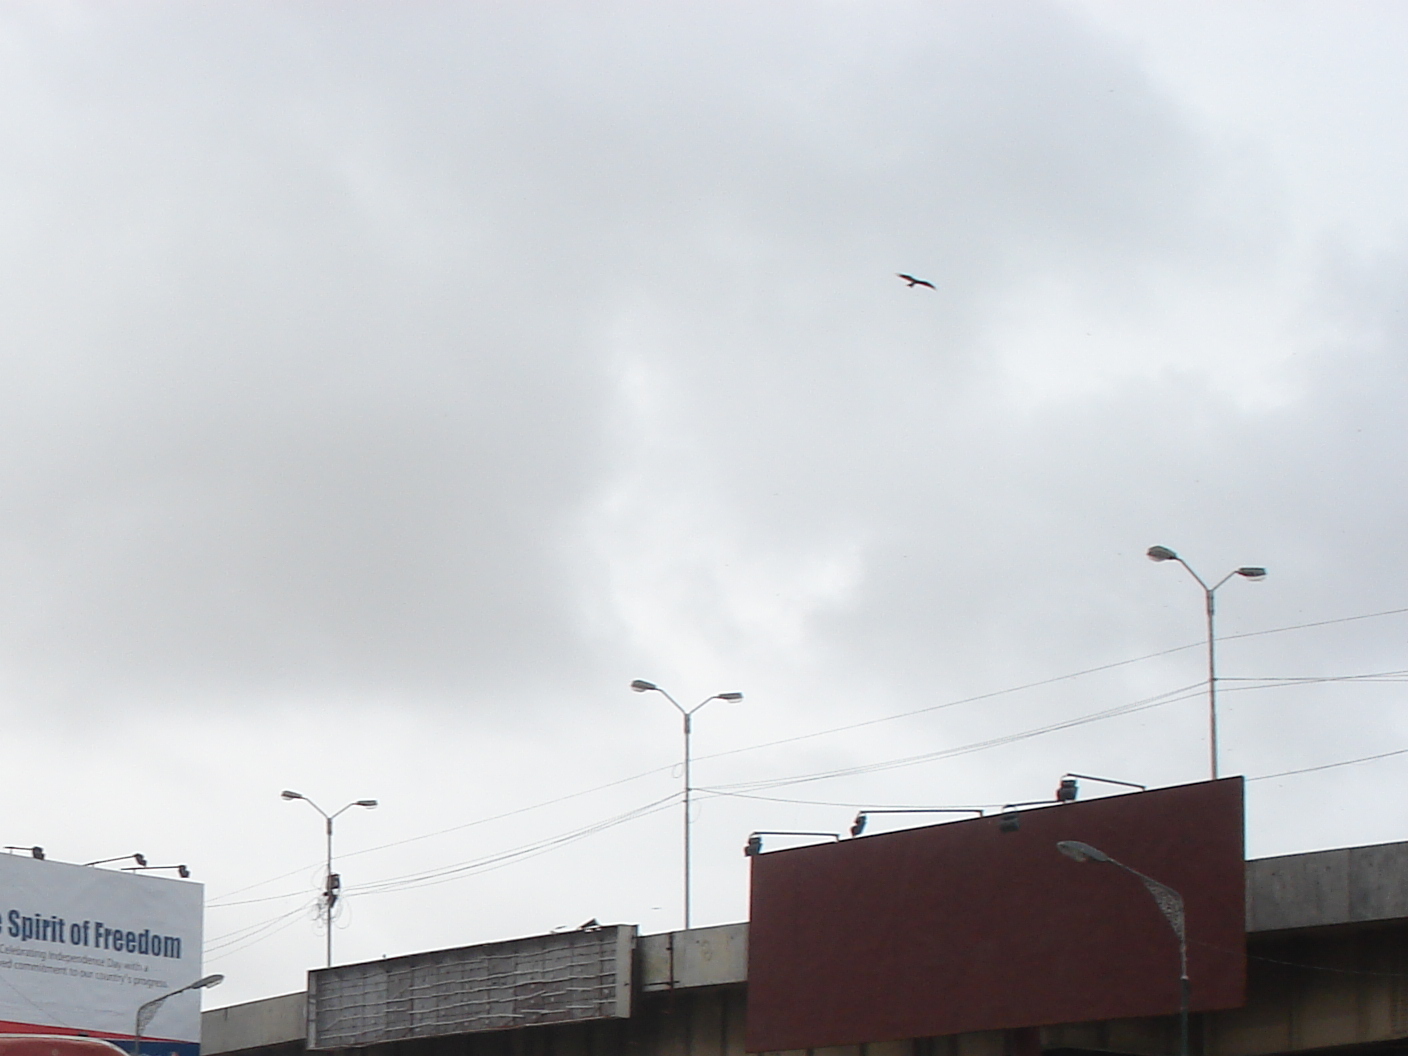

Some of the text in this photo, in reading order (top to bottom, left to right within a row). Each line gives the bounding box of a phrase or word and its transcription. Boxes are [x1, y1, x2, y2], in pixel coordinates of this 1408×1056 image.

[7, 909, 65, 944] Spirit
[70, 920, 90, 947] of
[94, 921, 182, 959] Freedom
[14, 962, 68, 975] commitment
[69, 968, 78, 977] to
[80, 970, 94, 978] our
[48, 950, 104, 968] Independence
[106, 958, 121, 971] Day
[124, 961, 143, 972] with
